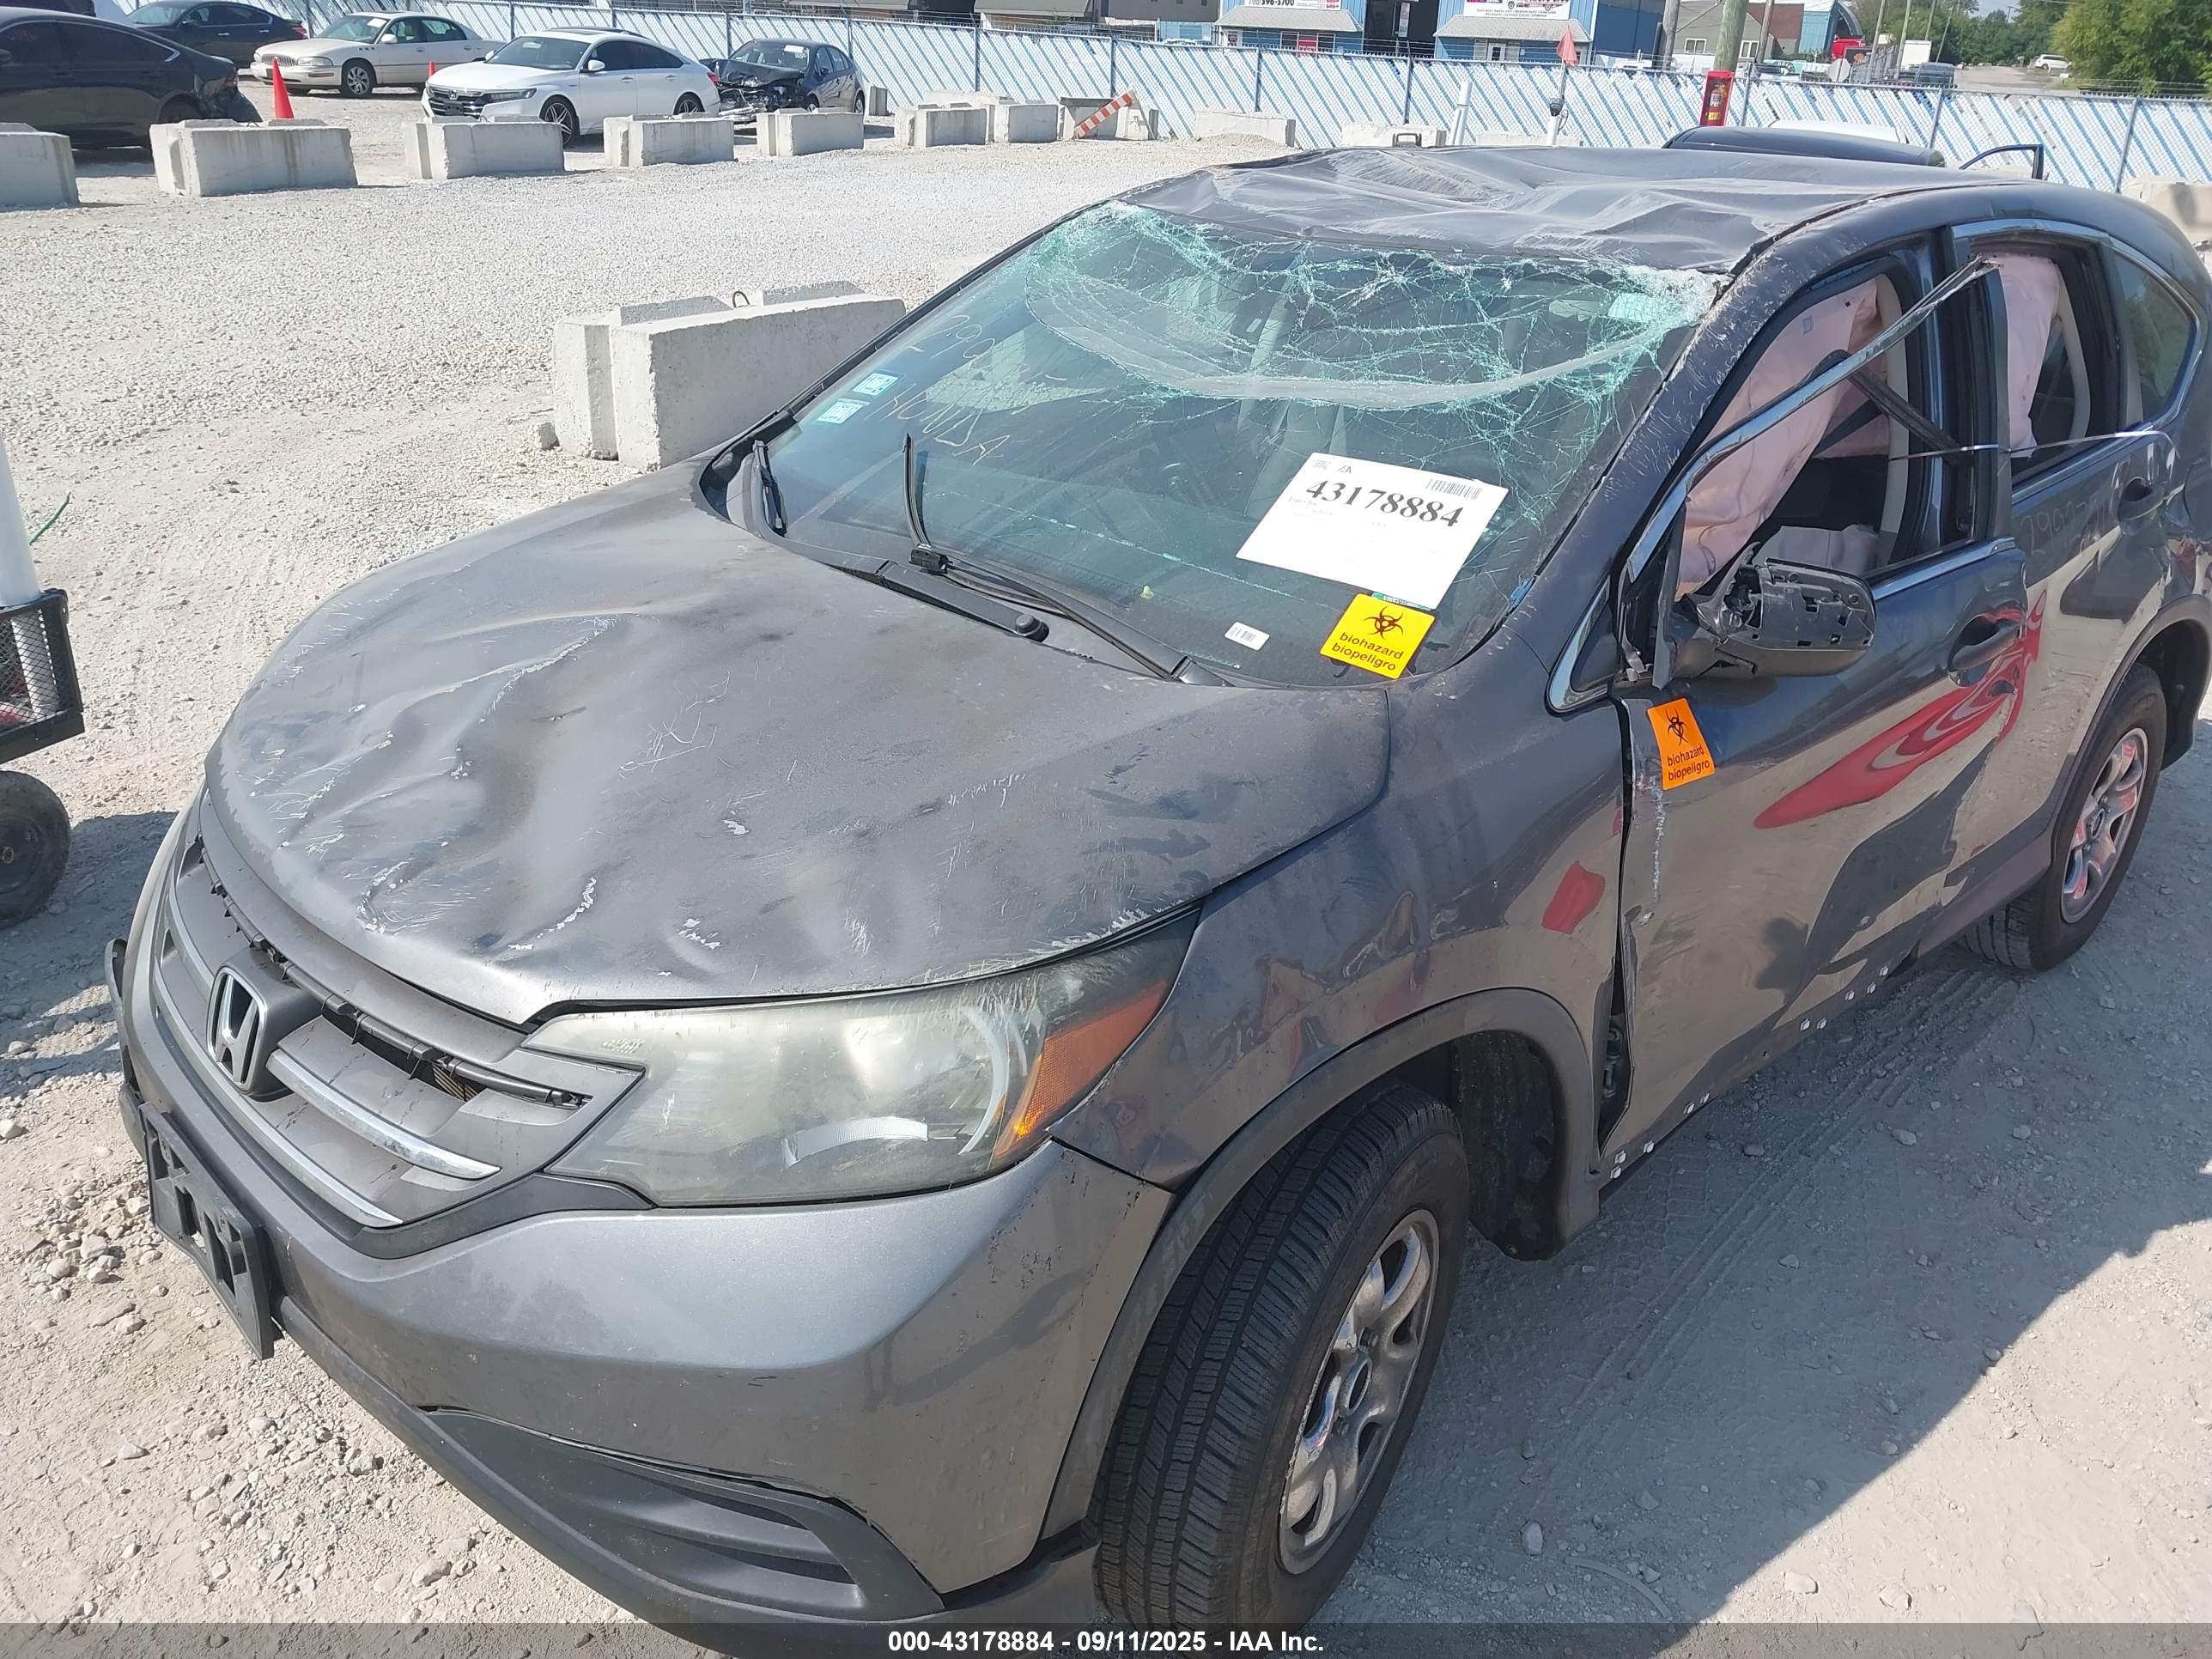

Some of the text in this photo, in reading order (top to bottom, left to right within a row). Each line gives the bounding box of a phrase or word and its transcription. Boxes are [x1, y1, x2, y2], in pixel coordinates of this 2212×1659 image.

[1306, 480, 1463, 528] 43178884
[1331, 642, 1397, 672] biopeligro
[1340, 631, 1404, 660] biohazard
[1667, 744, 1705, 767] biohazard
[1668, 759, 1711, 781] biopeligro
